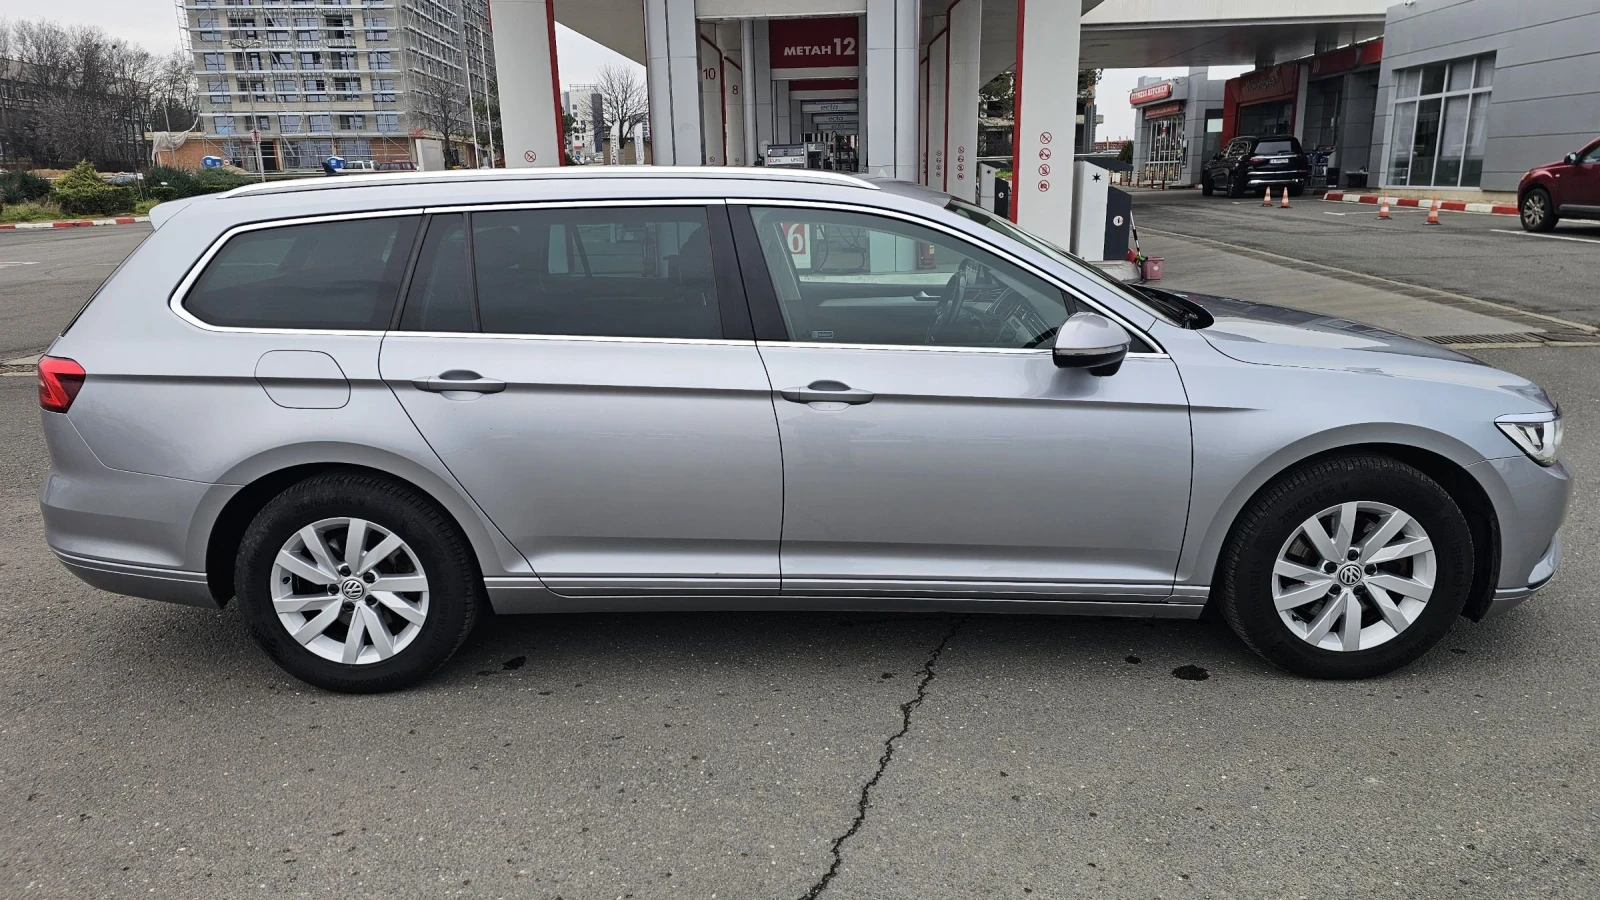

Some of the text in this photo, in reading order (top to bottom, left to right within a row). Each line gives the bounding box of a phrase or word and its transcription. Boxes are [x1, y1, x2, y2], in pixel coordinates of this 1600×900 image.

[784, 37, 856, 56] МЕТАН 12
[703, 67, 716, 80] 10
[732, 84, 739, 95] 8
[820, 103, 839, 111] ecto
[787, 223, 804, 253] 6
